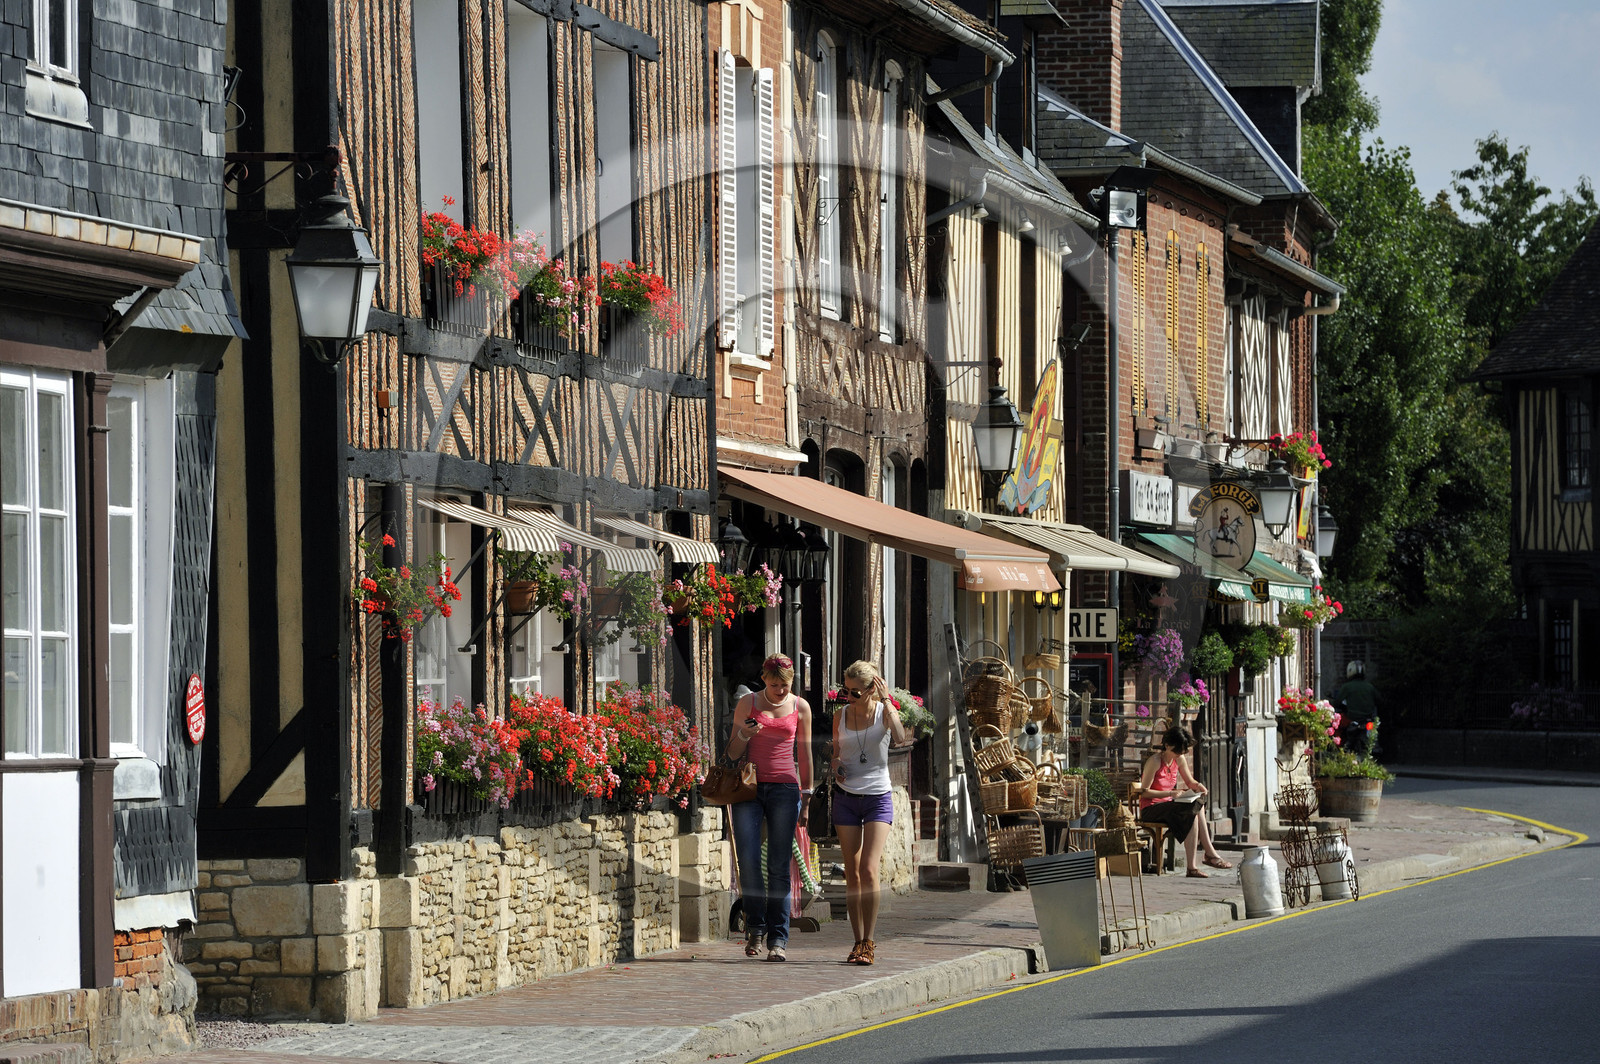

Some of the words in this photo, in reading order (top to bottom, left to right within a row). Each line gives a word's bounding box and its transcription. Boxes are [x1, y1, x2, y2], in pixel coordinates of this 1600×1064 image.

[1192, 494, 1211, 512] LA
[1210, 484, 1257, 509] FORGE
[1192, 581, 1265, 601] RESTANT
[1070, 612, 1107, 638] RIE
[1134, 616, 1151, 630] La
[1157, 616, 1192, 631] Forge
